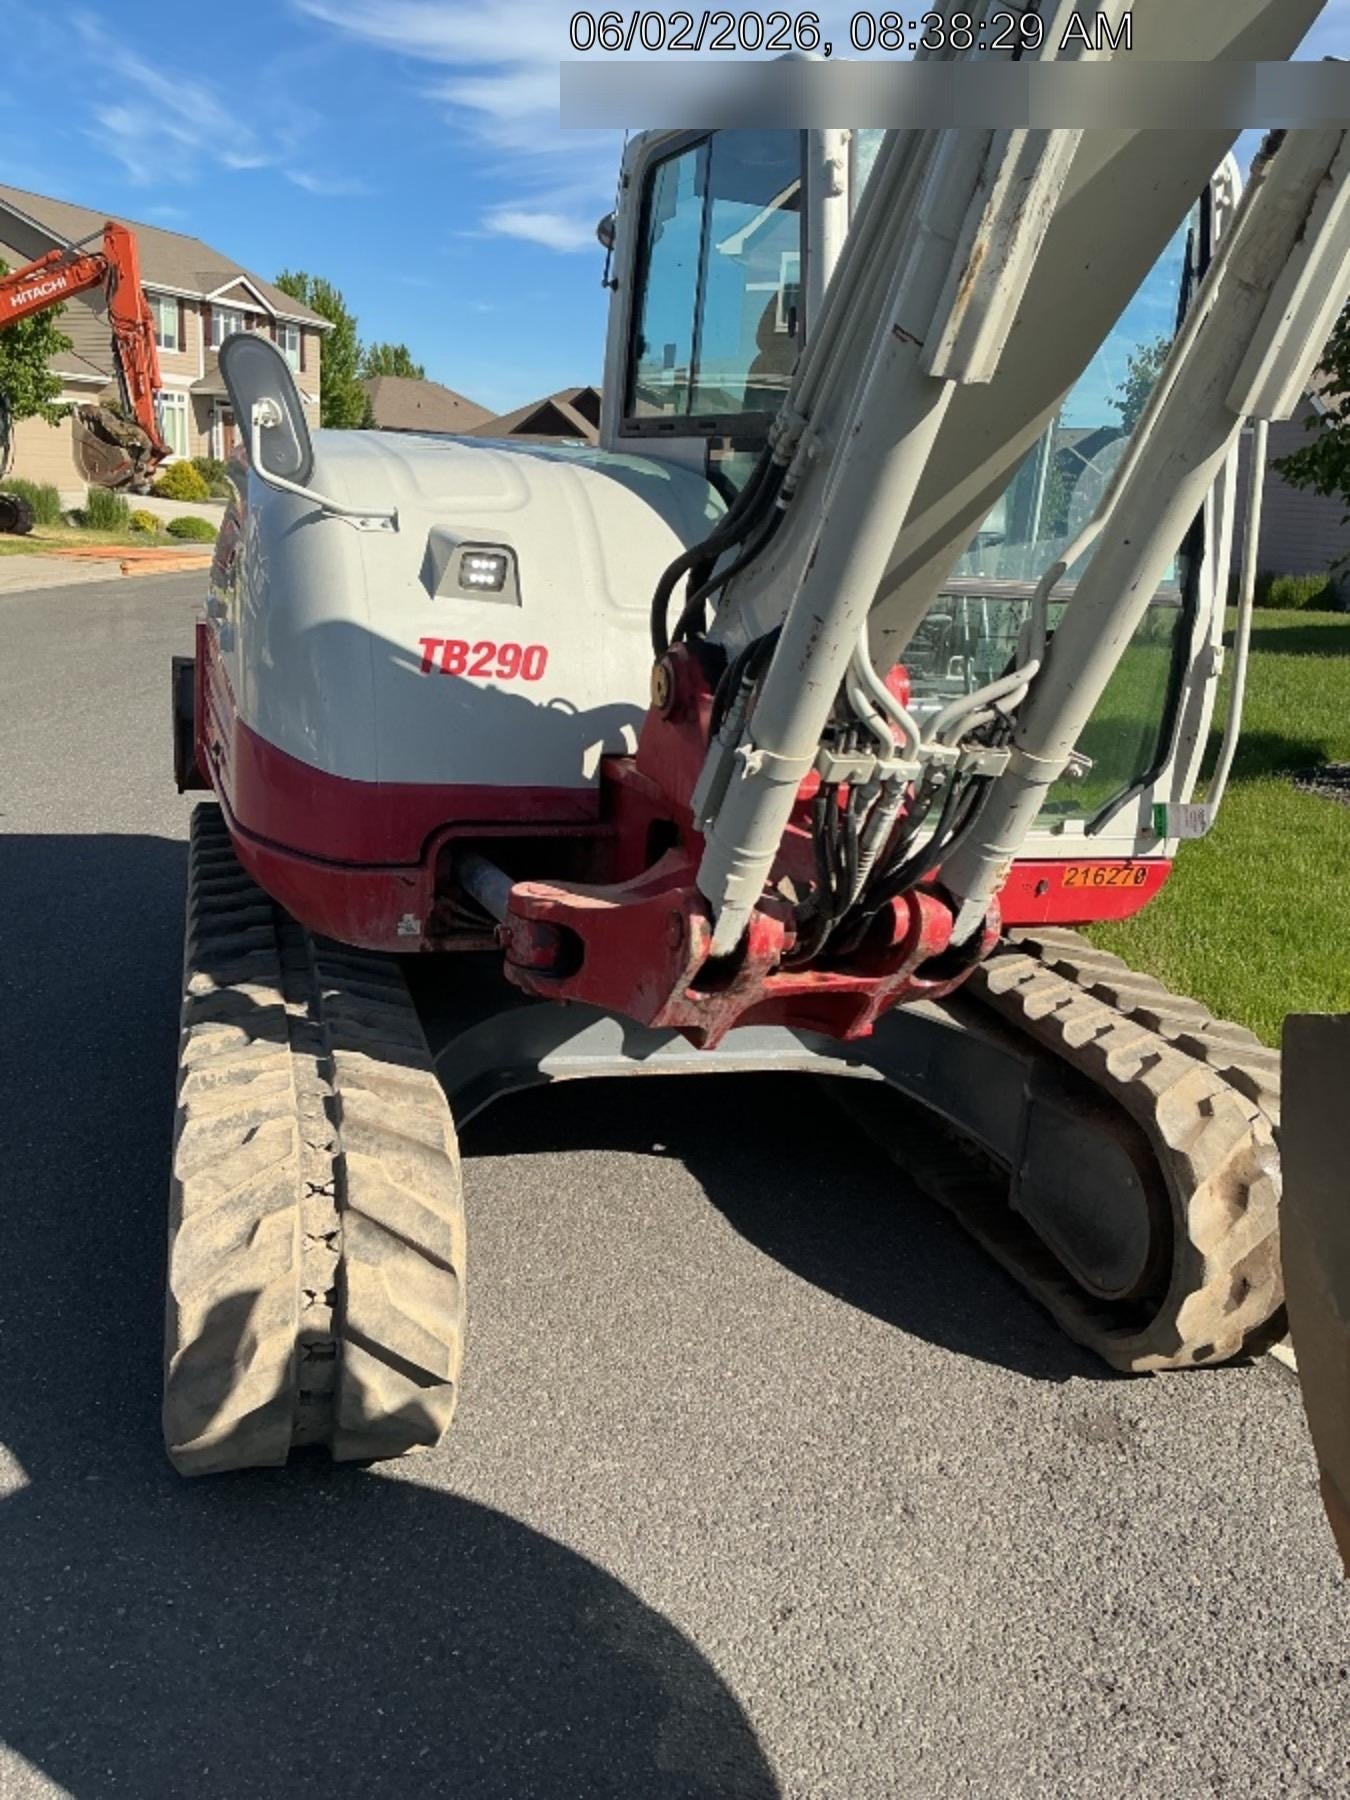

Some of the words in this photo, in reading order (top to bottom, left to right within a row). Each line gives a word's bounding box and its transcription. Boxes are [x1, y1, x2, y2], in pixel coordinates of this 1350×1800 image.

[10, 276, 67, 307] HITACHI
[419, 637, 549, 681] TB290
[1063, 867, 1147, 886] 216270
